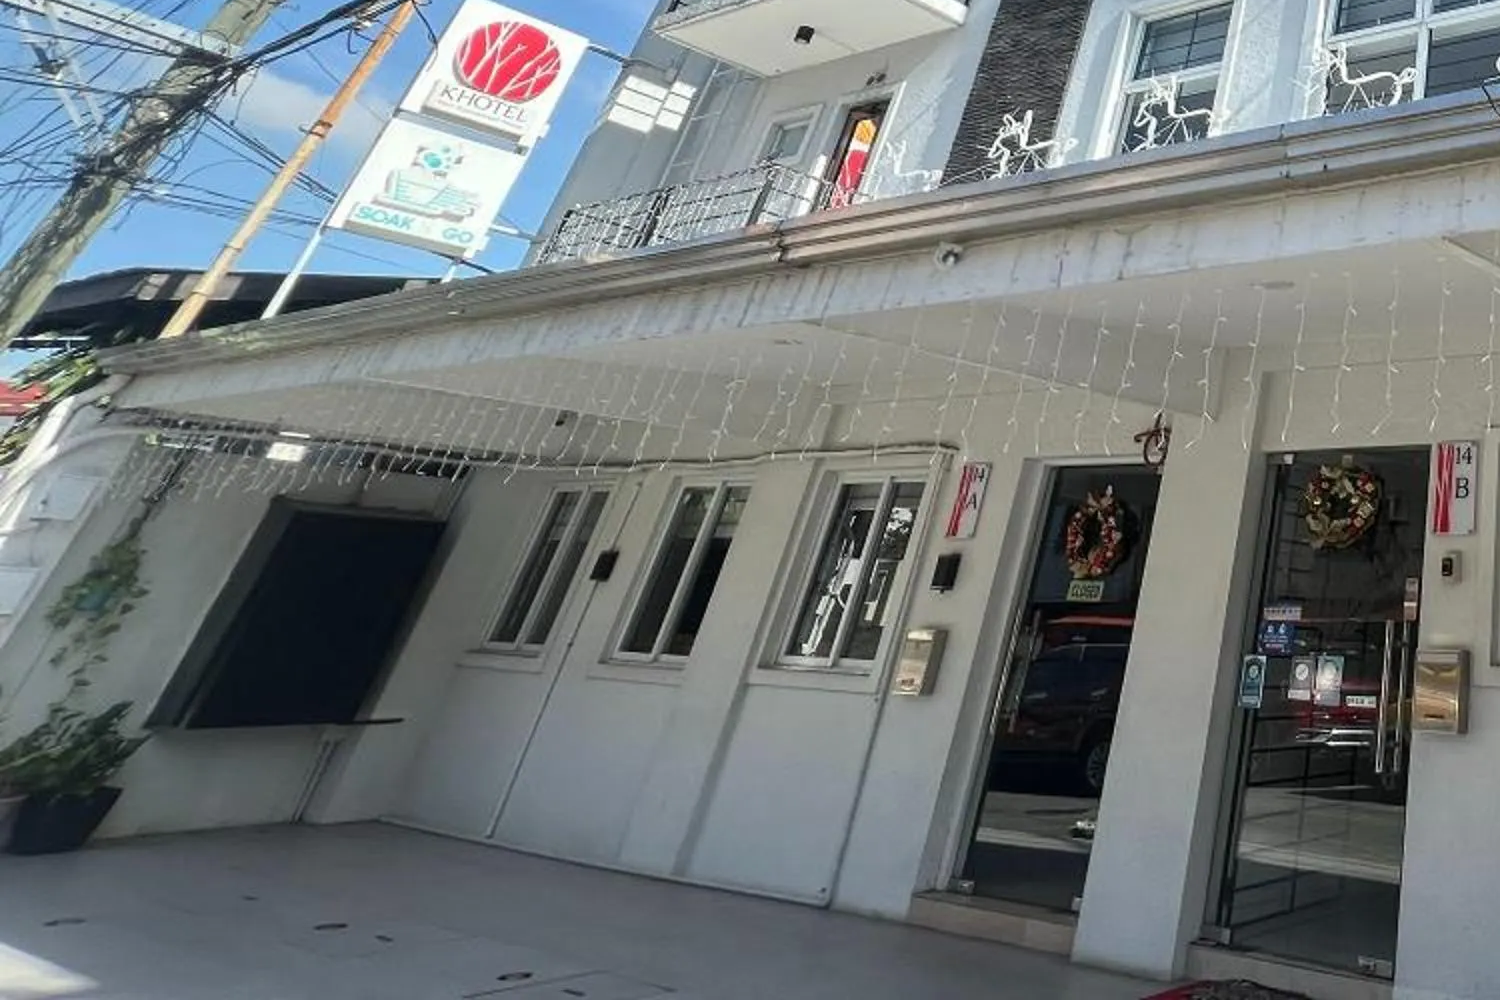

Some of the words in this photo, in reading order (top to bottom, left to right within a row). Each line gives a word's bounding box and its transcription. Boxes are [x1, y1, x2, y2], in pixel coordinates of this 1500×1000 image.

[440, 84, 528, 123] KHOTEL
[355, 205, 416, 231] SOAK
[442, 227, 474, 244] GO
[1456, 446, 1472, 465] 14
[1455, 477, 1470, 499] B
[965, 493, 977, 510] A
